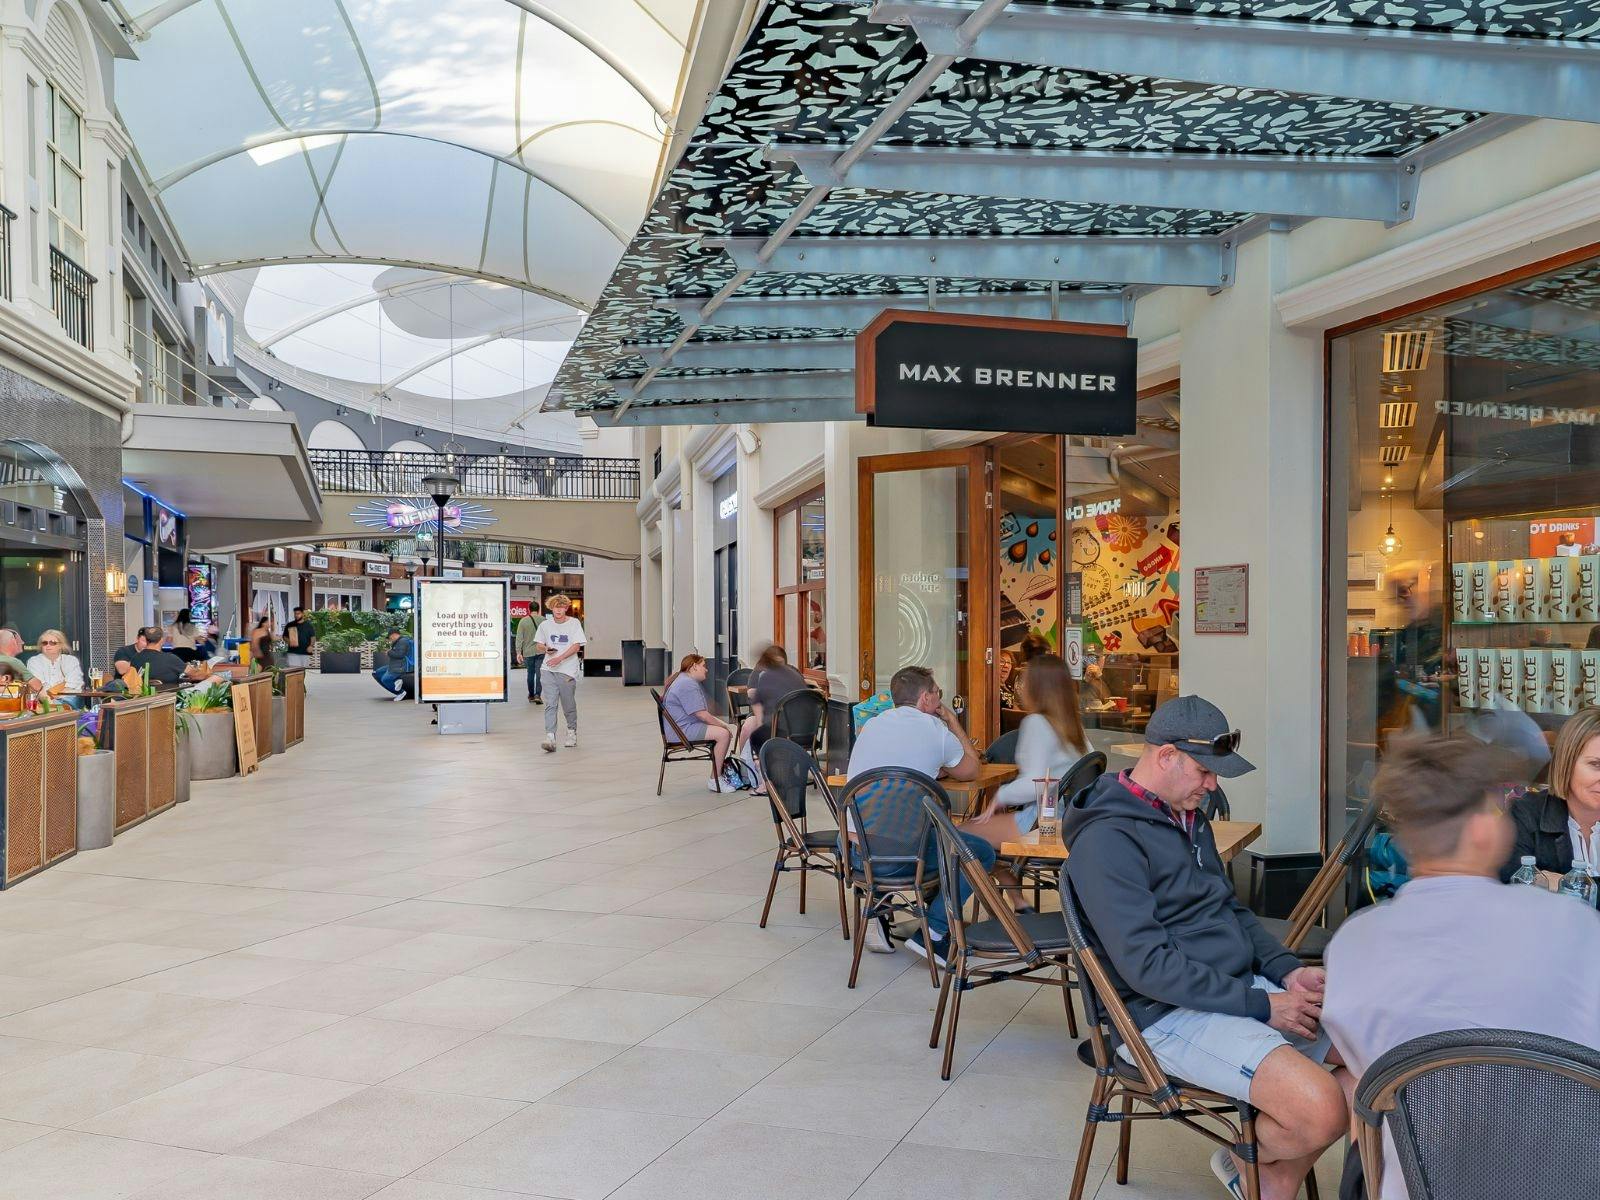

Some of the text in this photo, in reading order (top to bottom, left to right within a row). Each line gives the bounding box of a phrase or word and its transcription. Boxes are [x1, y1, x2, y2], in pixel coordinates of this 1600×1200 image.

[899, 363, 1116, 392] MAX BRENNER
[394, 505, 453, 526] INFINIY
[1549, 522, 1580, 533] DRINKS
[510, 604, 527, 616] oles
[1454, 569, 1464, 614] ALICE
[1475, 567, 1484, 613] ALICE
[1499, 567, 1510, 614] ALICE
[1525, 565, 1535, 613] ALICE
[1552, 564, 1562, 613] ALICE
[1581, 562, 1593, 613] ALICE
[431, 621, 476, 630] everything
[437, 611, 488, 621] Load up with
[437, 629, 457, 637] need
[469, 629, 488, 638] quit.
[1459, 655, 1470, 699] ALICE
[1480, 655, 1490, 700] ALICE
[1502, 656, 1513, 702] ALICE
[1526, 656, 1537, 704] ALICE
[1554, 657, 1565, 705] ALICE
[1584, 657, 1597, 705] ALICE
